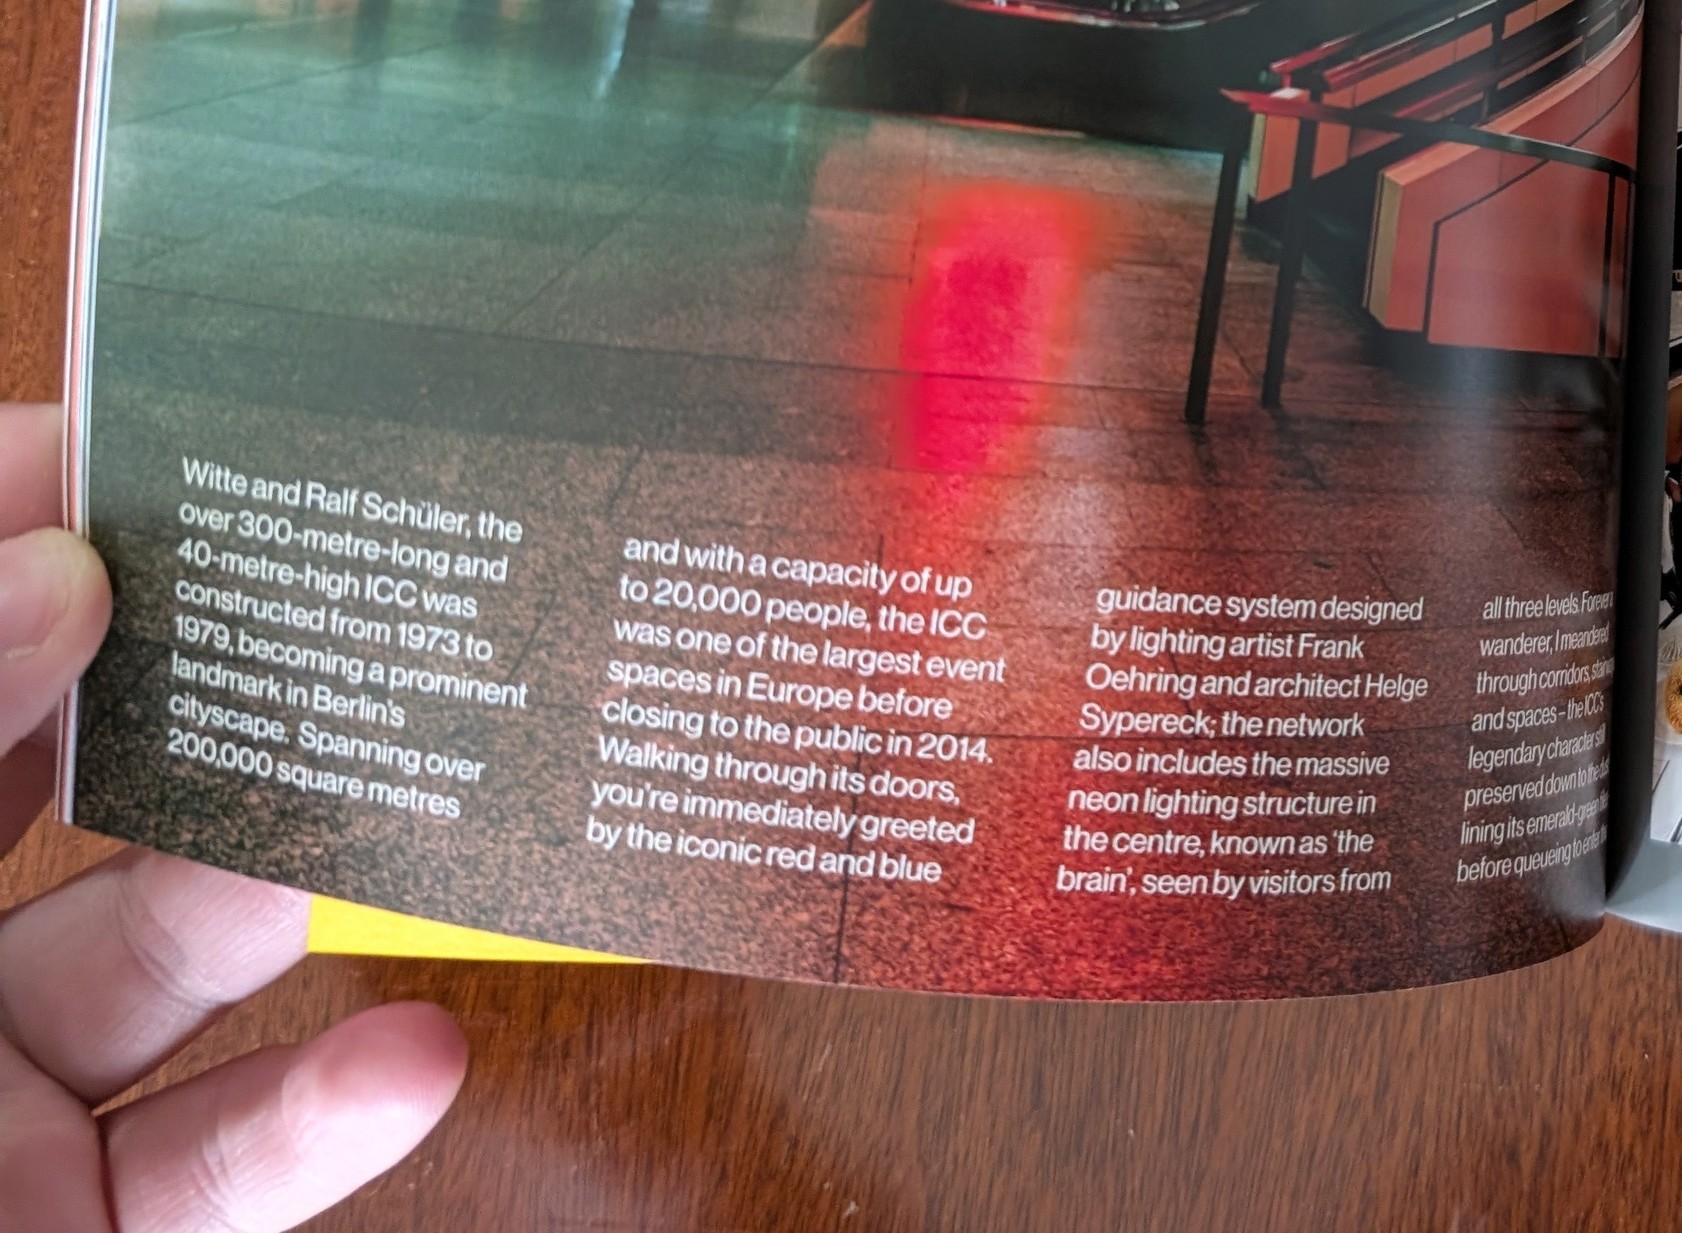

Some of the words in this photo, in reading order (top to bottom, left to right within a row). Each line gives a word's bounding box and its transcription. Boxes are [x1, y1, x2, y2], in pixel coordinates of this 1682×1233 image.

[182, 457, 247, 495] Witte
[253, 478, 300, 505] and
[307, 482, 359, 515] Ralf
[363, 492, 470, 538] Schüler,
[478, 510, 523, 543] the
[180, 502, 234, 531] over
[239, 513, 449, 575] 300-metre-long
[455, 553, 508, 583] and
[178, 538, 359, 604] 40-metre-high
[366, 577, 418, 608] ICC
[422, 591, 477, 619] was
[624, 537, 679, 566] and
[685, 545, 744, 571] with
[750, 556, 765, 576] a
[773, 554, 897, 597] capacity
[901, 568, 932, 595] of
[935, 575, 972, 602] up
[175, 579, 325, 632] constructed
[330, 609, 391, 644] from
[399, 623, 459, 657] 1973
[465, 633, 493, 661] to
[620, 575, 648, 602] to
[653, 578, 762, 616] 20,000
[765, 595, 871, 632] people,
[878, 606, 925, 634] the
[930, 610, 987, 640] ICC
[1097, 587, 1221, 615] guidance
[1225, 596, 1316, 622] system
[1320, 596, 1424, 625] designed
[1483, 596, 1502, 620] all
[1505, 595, 1544, 618] three
[1545, 593, 1579, 618] levels.
[174, 615, 233, 655] 1979,
[238, 630, 363, 682] becoming
[368, 661, 384, 682] a
[389, 666, 528, 708] prominent
[614, 619, 671, 646] was
[677, 627, 731, 656] one
[737, 630, 765, 658] of
[771, 633, 817, 664] the
[822, 641, 921, 679] largest
[927, 654, 1006, 683] event
[1090, 623, 1126, 655] by
[1130, 626, 1225, 661] lighting
[1230, 632, 1294, 658] artist
[1298, 633, 1365, 659] Frank
[1480, 634, 1553, 656] wanderer,
[1555, 631, 1560, 650] I
[1561, 620, 1609, 649] meandered
[172, 650, 282, 702] landmark
[286, 681, 308, 707] in
[313, 687, 406, 727] Berlin's
[607, 658, 711, 693] spaces
[716, 672, 742, 697] in
[747, 673, 853, 713] Europe
[858, 685, 953, 719] before
[1085, 662, 1197, 699] Oehring
[1202, 671, 1251, 696] and
[1254, 672, 1361, 698] architect
[1365, 673, 1428, 702] Helge
[1477, 670, 1537, 696] through
[1539, 661, 1591, 689] corridors,
[169, 692, 289, 744] cityscape.
[299, 722, 420, 775] Spanning
[425, 751, 485, 781] over
[602, 698, 704, 738] closing
[709, 711, 738, 738] to
[744, 713, 790, 745] the
[795, 722, 882, 762] public
[887, 730, 912, 757] in
[917, 734, 993, 764] 2014.
[1079, 703, 1216, 738] Sypereck;
[1221, 710, 1262, 736] the
[1267, 712, 1365, 737] network
[1472, 706, 1505, 731] and
[1507, 707, 1556, 732] spaces
[1567, 697, 1584, 720] the
[168, 727, 273, 779] 200,000
[277, 757, 364, 798] square
[368, 783, 460, 819] metres
[599, 735, 709, 778] Walking
[715, 753, 827, 791] through
[831, 766, 865, 791] its
[869, 771, 960, 806] doors,
[1073, 745, 1131, 772] also
[1136, 748, 1247, 776] includes
[1251, 751, 1292, 776] the
[1296, 750, 1390, 776] massive
[1468, 738, 1546, 772] legendary
[1547, 731, 1595, 760] character
[591, 779, 679, 812] you're
[683, 790, 856, 839] immediately
[860, 809, 975, 844] greeted
[1068, 789, 1138, 813] neon
[1143, 787, 1238, 821] lighting
[1243, 792, 1352, 817] structure
[1357, 791, 1376, 814] in
[1464, 773, 1544, 811] preserved
[1546, 771, 1577, 798] down
[1578, 767, 1587, 788] to
[586, 817, 622, 851] by
[627, 823, 672, 853] the
[677, 829, 762, 864] iconic
[765, 845, 815, 868] red
[820, 849, 875, 877] and
[880, 852, 942, 883] blue
[1063, 825, 1108, 851] the
[1112, 830, 1205, 858] centre,
[1210, 829, 1295, 856] known
[1300, 834, 1328, 854] as
[1461, 819, 1504, 845] lining
[1507, 815, 1524, 839] its
[1142, 872, 1208, 894] seen
[1212, 869, 1246, 900] by
[1248, 869, 1336, 896] visitors
[1340, 868, 1391, 892] from
[1457, 856, 1511, 883] before
[1514, 843, 1571, 879] queueing
[1572, 837, 1582, 858] to
